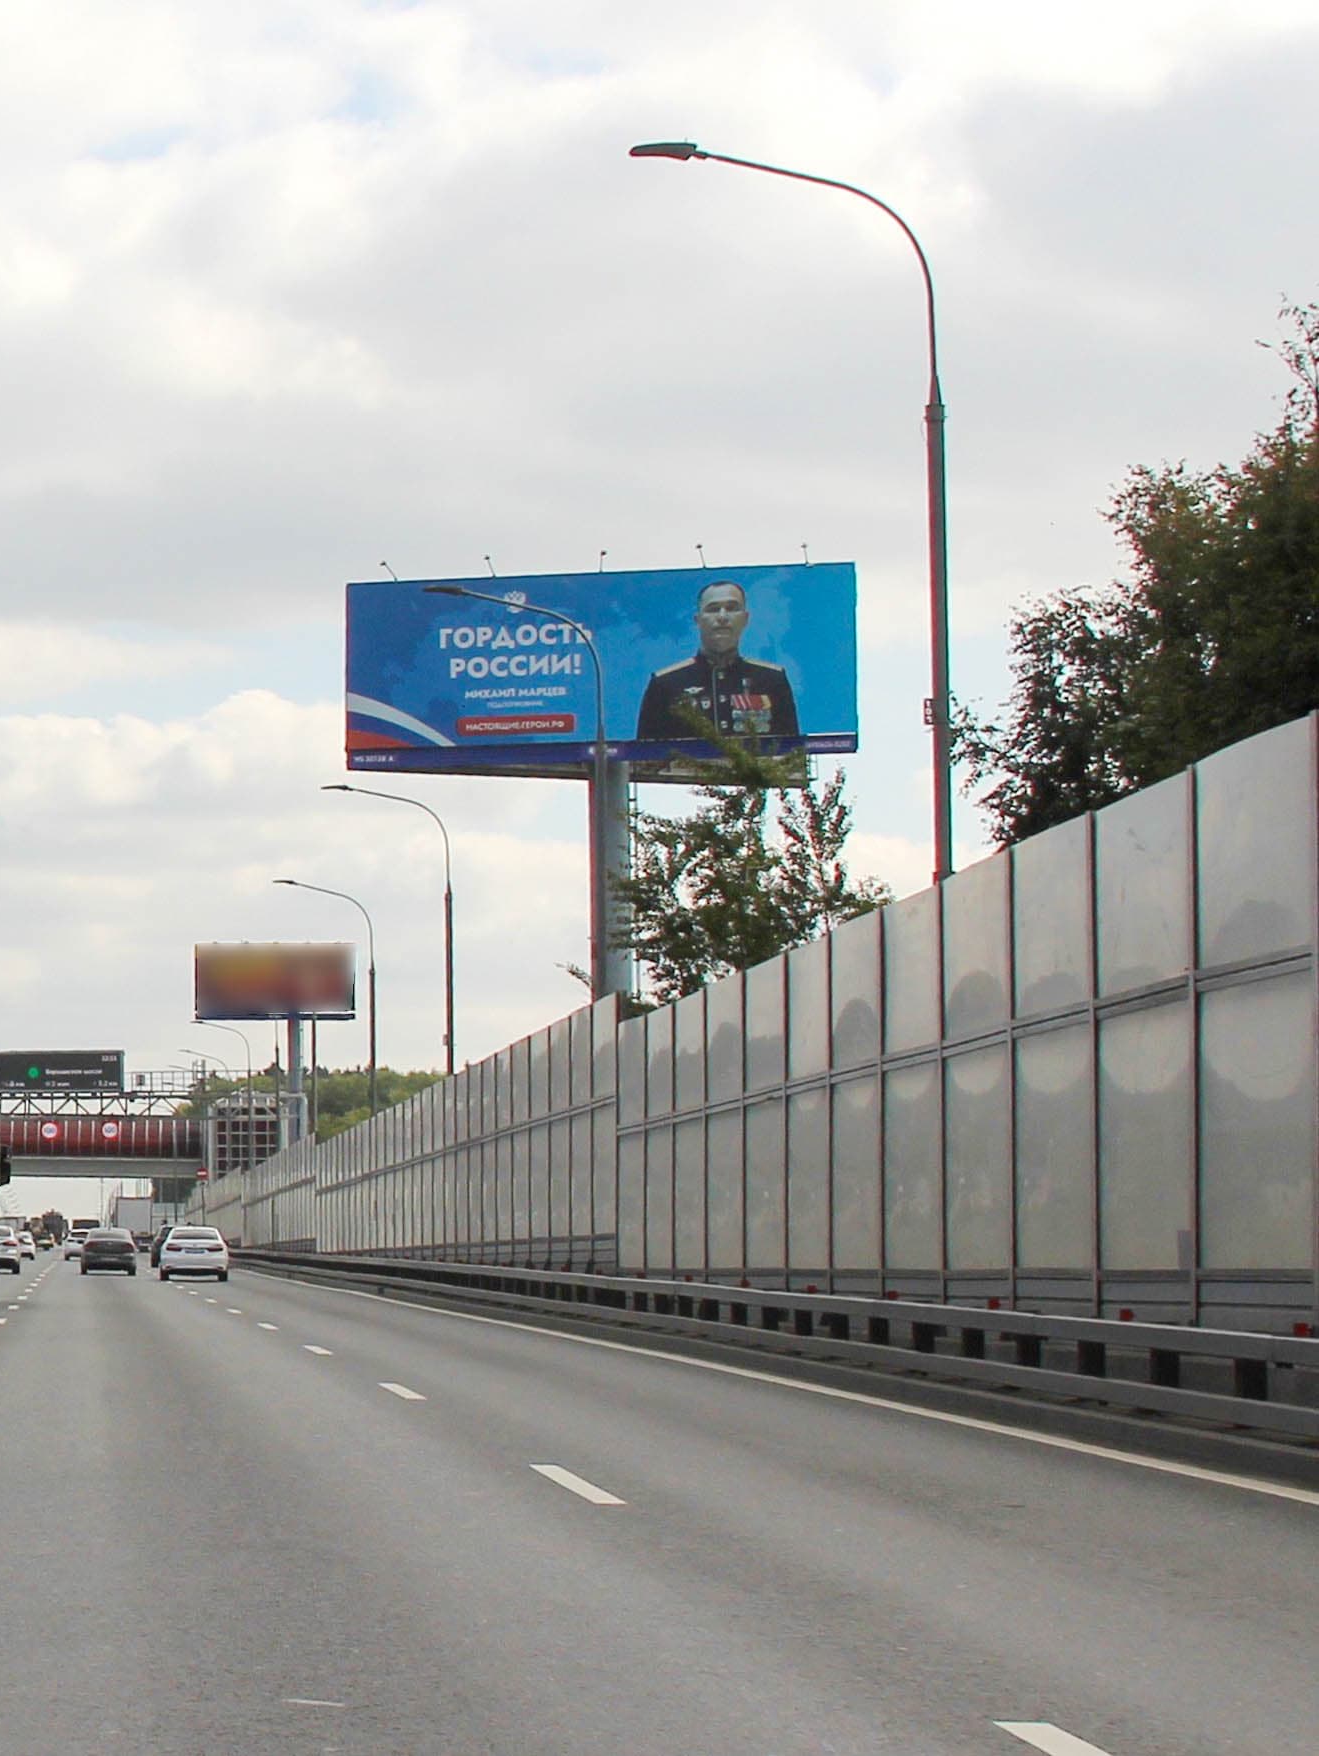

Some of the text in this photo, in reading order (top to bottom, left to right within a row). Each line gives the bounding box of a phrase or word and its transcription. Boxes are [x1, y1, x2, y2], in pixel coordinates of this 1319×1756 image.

[439, 623, 593, 650] ГОРДОСТЬ
[449, 653, 582, 679] РОССИИ!
[464, 687, 516, 699] МИХАИЛ
